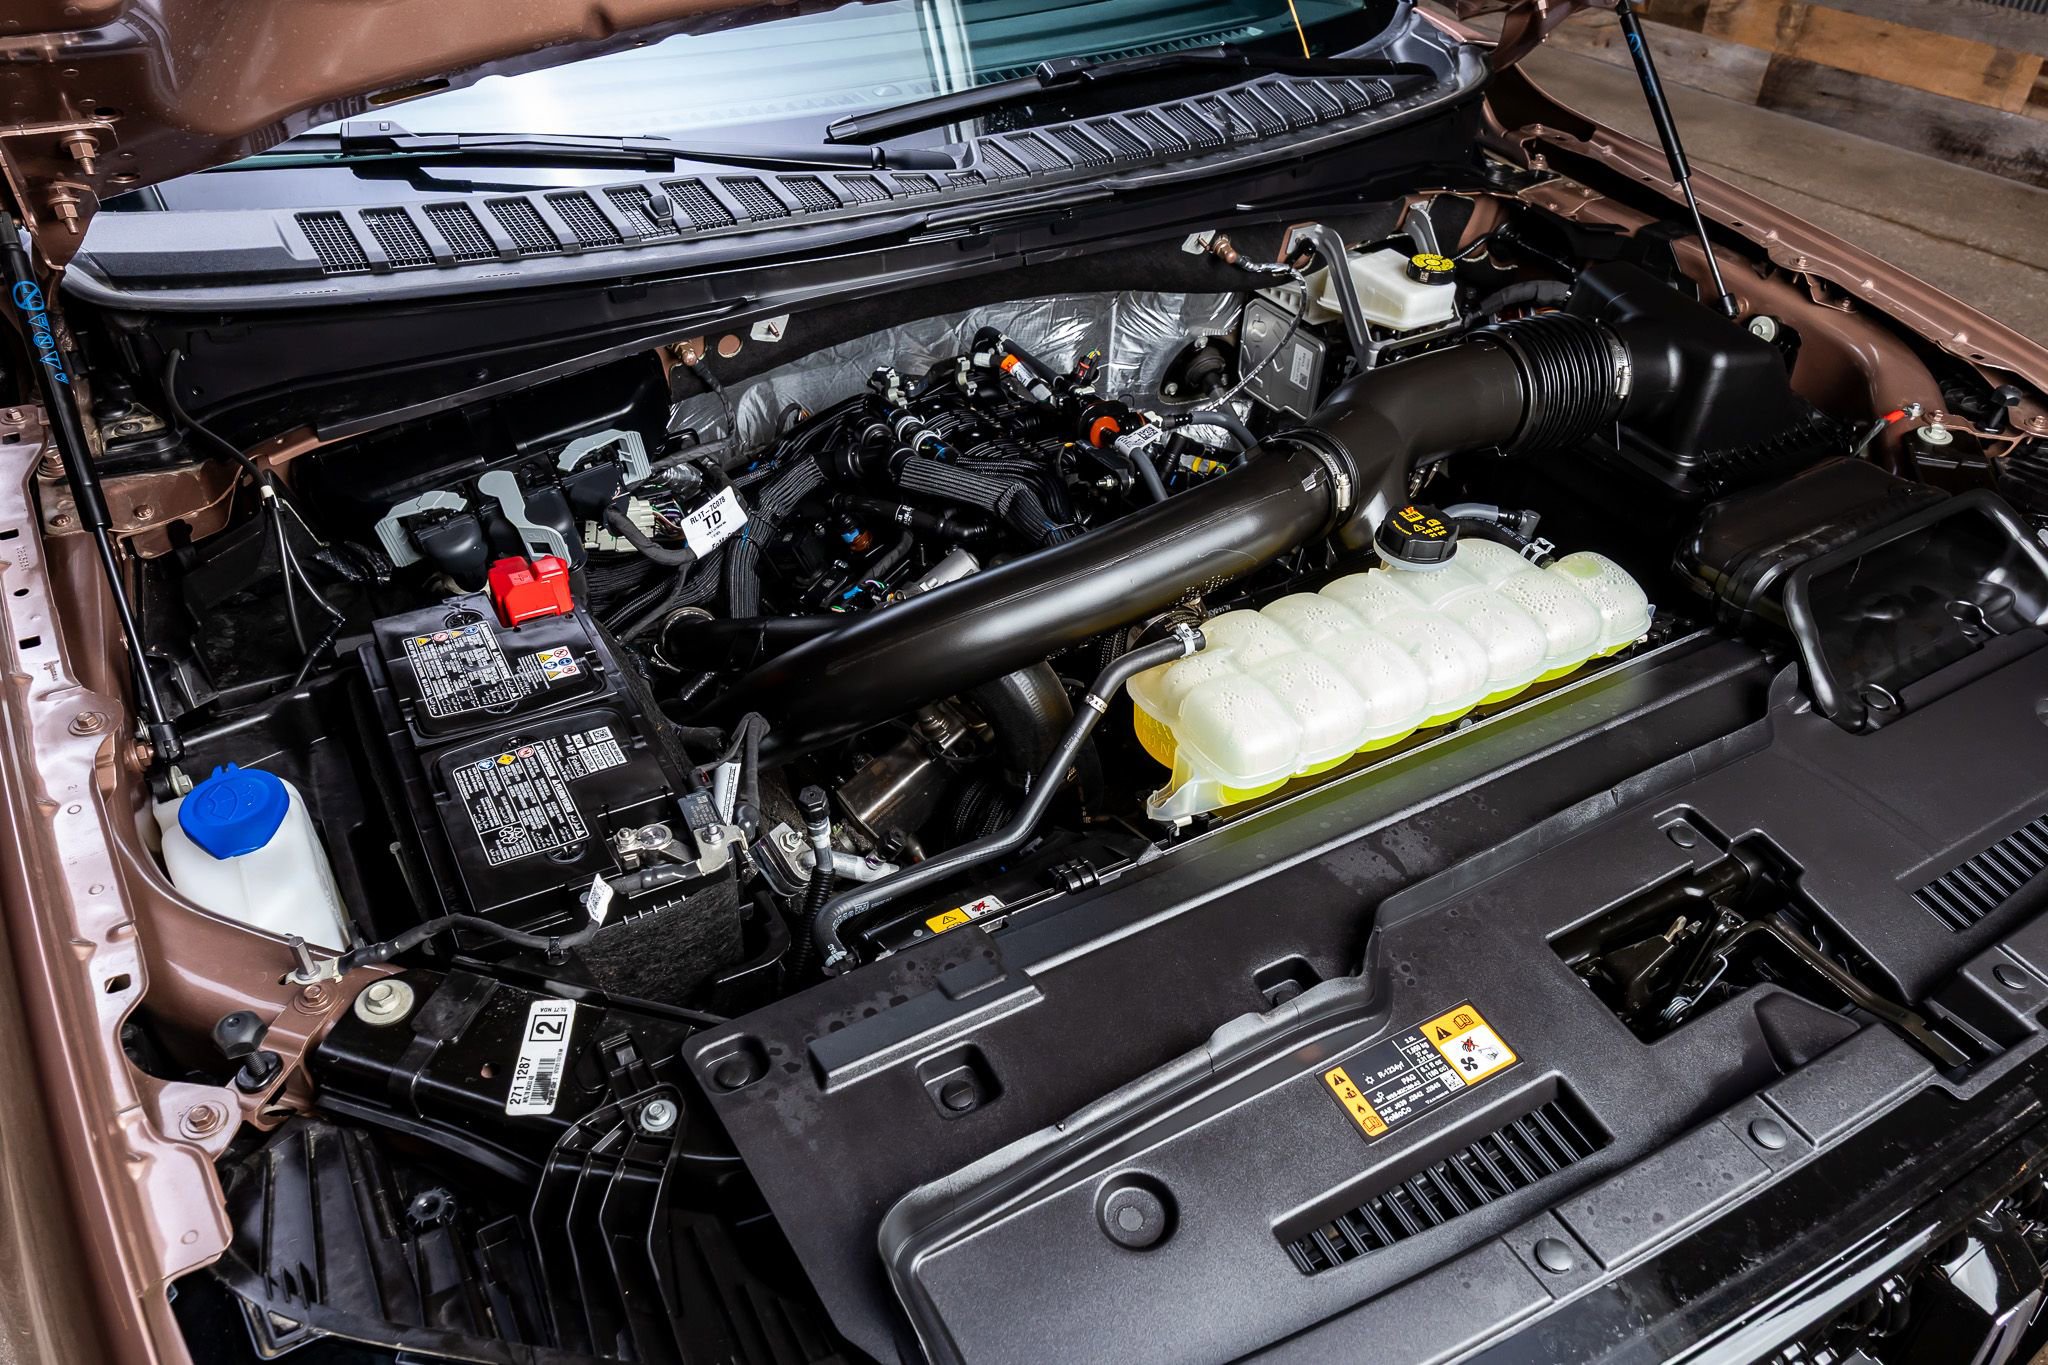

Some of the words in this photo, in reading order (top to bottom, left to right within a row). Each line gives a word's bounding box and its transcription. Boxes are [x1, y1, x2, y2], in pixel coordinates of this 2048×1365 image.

[703, 510, 722, 529] TD
[712, 532, 735, 550] FoMoC
[536, 1021, 562, 1035] 2
[516, 1056, 531, 1081] 1287
[1377, 1061, 1405, 1079] R-1234yf
[1401, 1074, 1416, 1085] PAG
[510, 1086, 524, 1105] 271
[1380, 1106, 1393, 1117] SAE
[1384, 1107, 1412, 1123] FoMoCo
